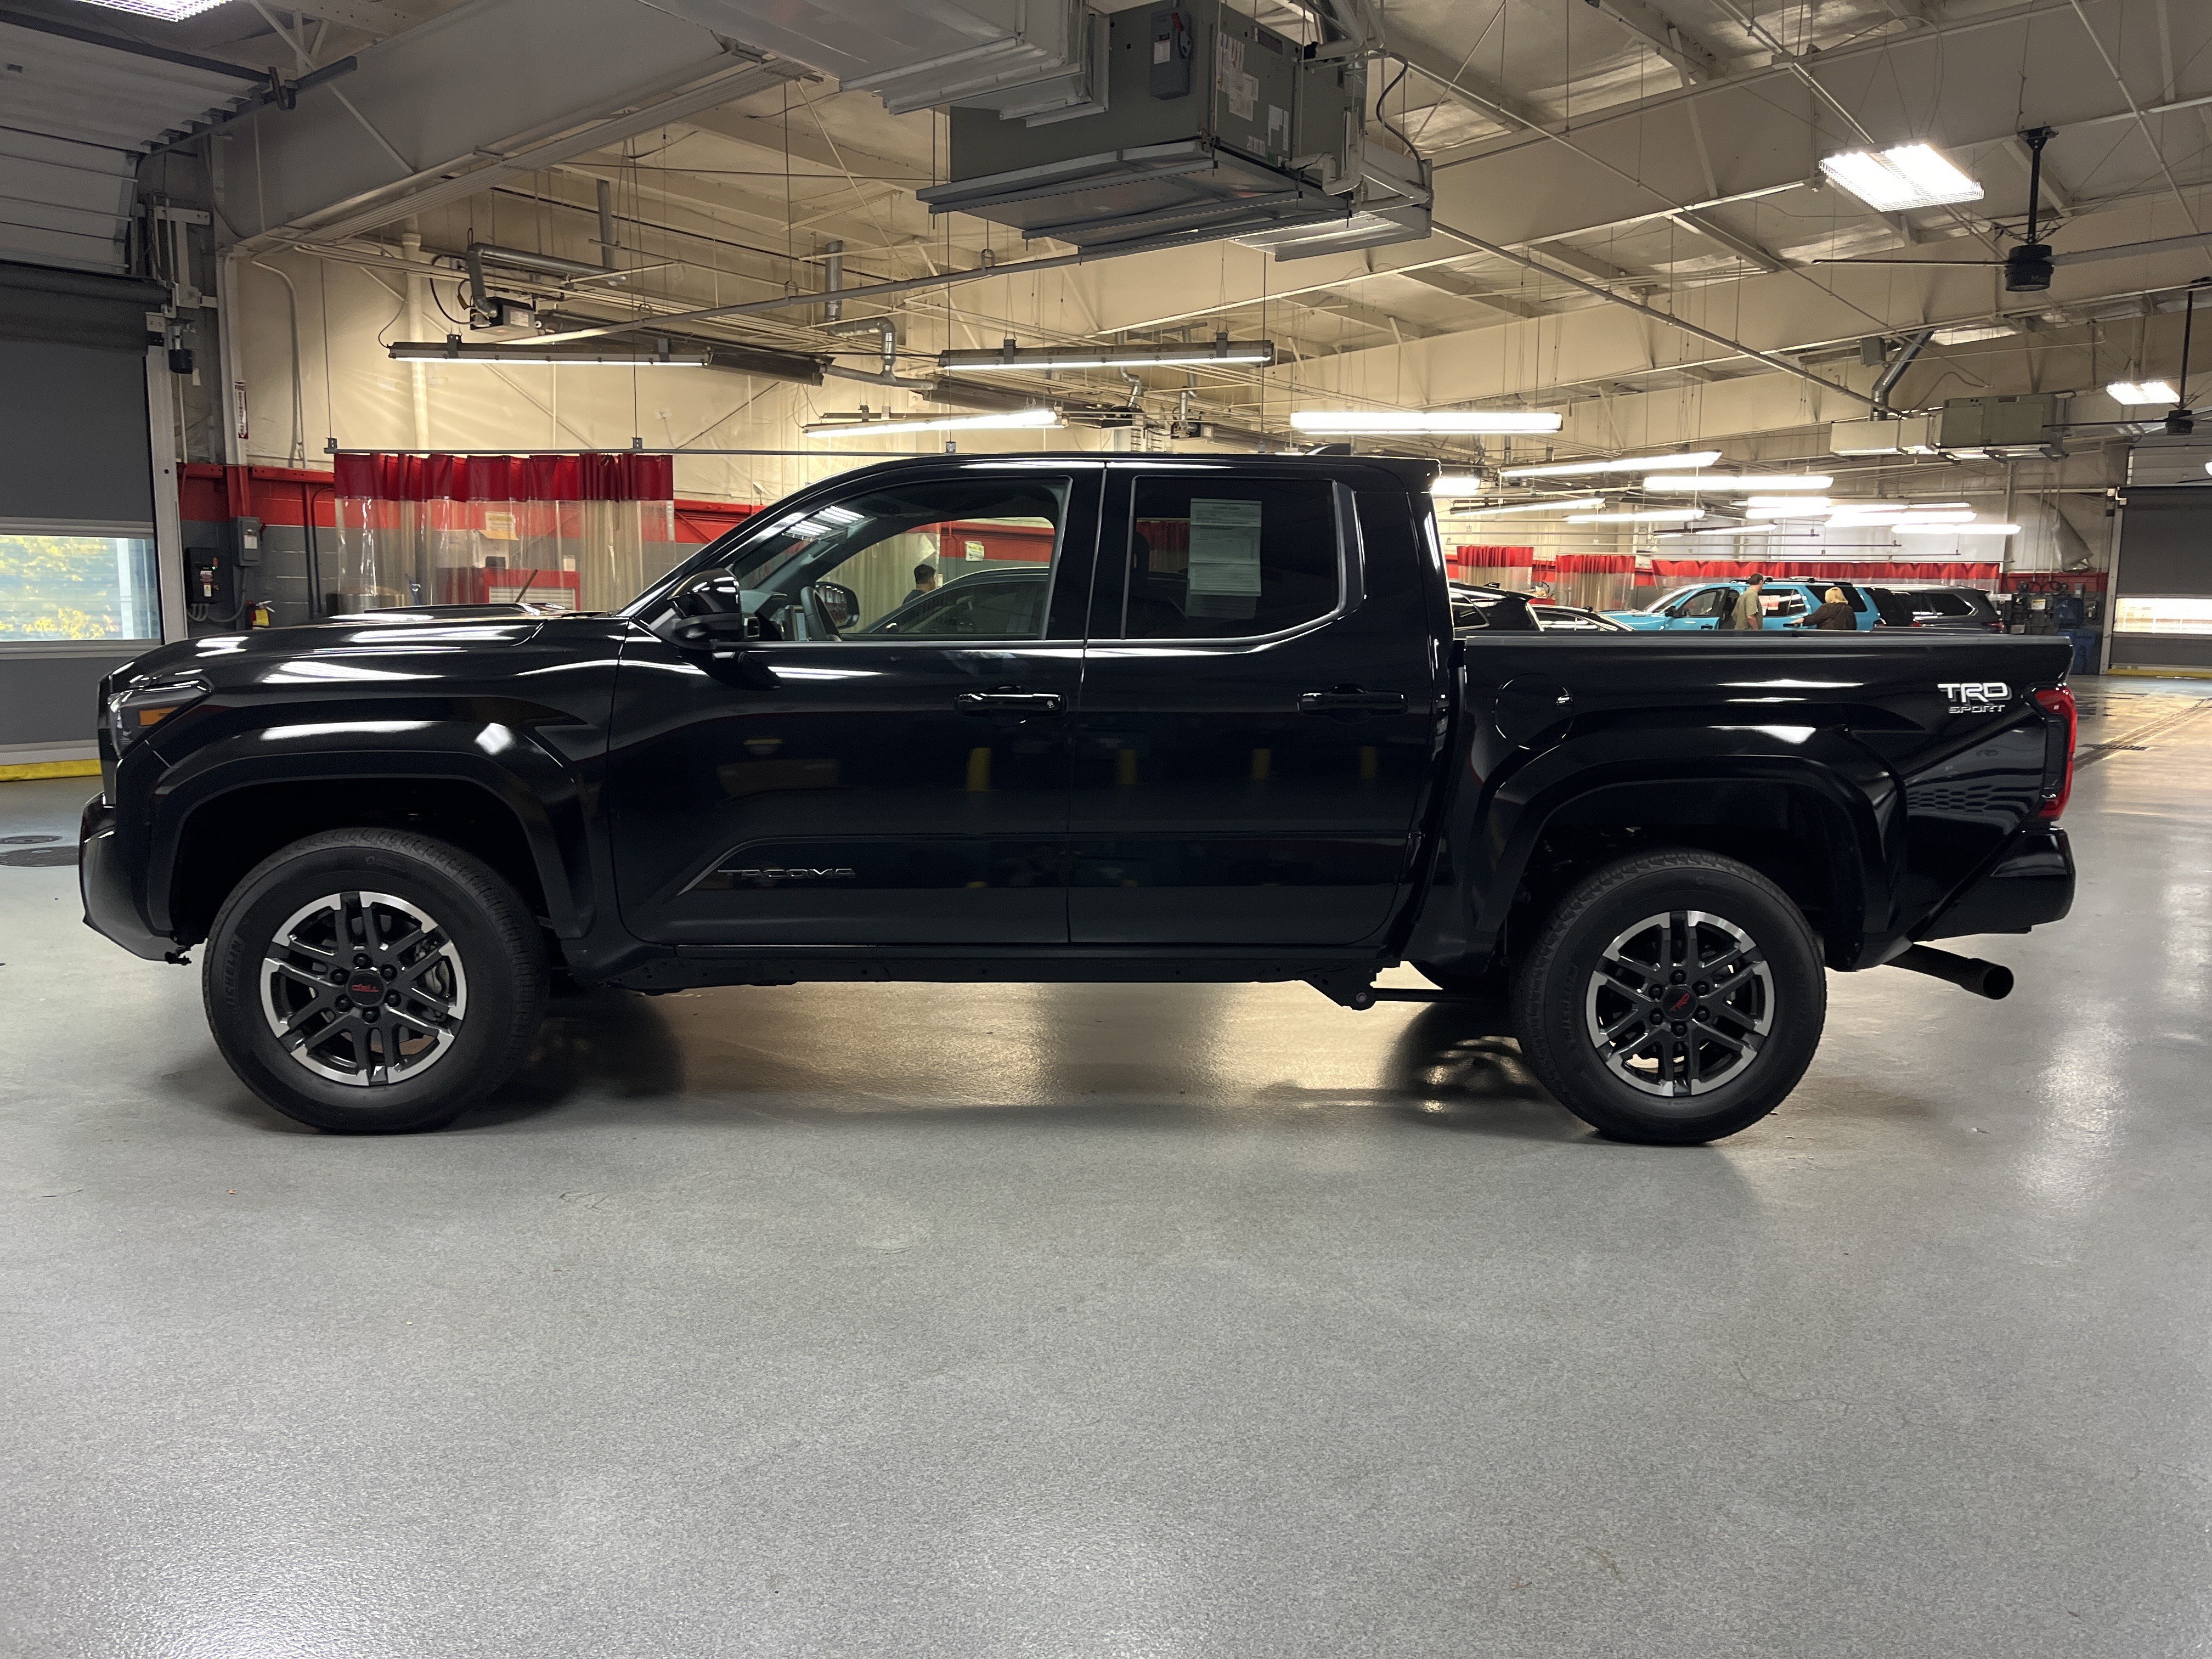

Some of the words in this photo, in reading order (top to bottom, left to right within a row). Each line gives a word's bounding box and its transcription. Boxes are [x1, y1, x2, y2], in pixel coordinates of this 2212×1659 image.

[1937, 682, 2008, 703] TRD
[1948, 704, 2006, 714] SPORT
[716, 868, 856, 879] TACOMA
